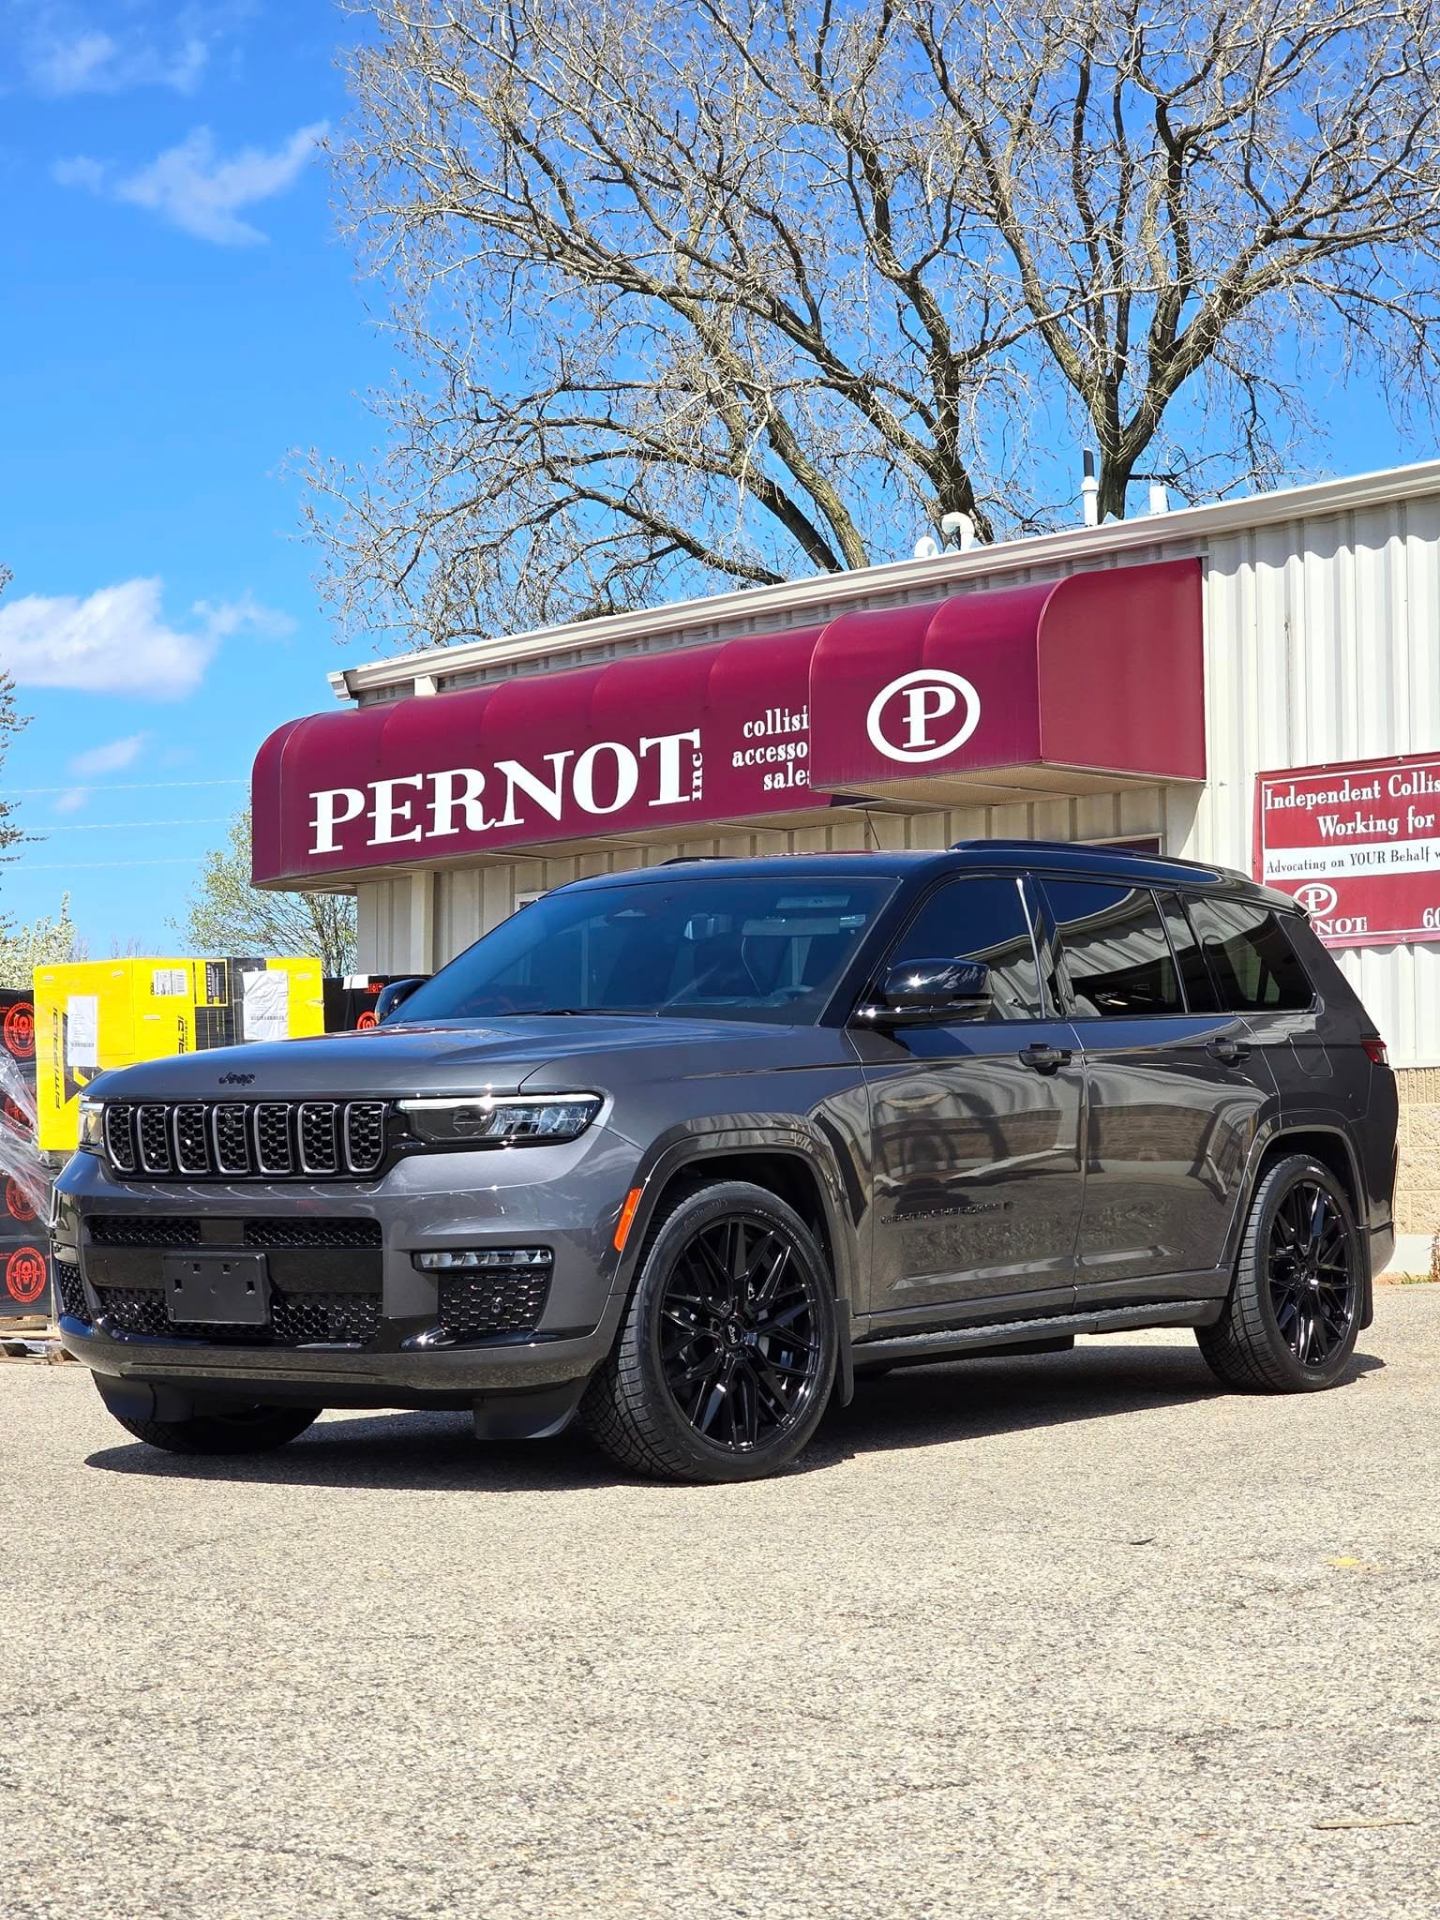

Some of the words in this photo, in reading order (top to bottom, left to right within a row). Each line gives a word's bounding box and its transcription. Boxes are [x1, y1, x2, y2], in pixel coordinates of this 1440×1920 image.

[743, 704, 809, 738] collisi
[902, 686, 956, 748] P
[732, 742, 808, 768] accesso
[308, 727, 701, 854] PERNOT
[763, 761, 810, 791] sale
[1265, 779, 1381, 810] Independent
[1388, 771, 1440, 797] Collis
[1317, 812, 1399, 838] Working
[1407, 805, 1435, 833] for
[1266, 858, 1326, 874] Advocating
[1331, 859, 1345, 868] on
[1350, 851, 1386, 866] YOUR
[1391, 846, 1430, 863] Behalf
